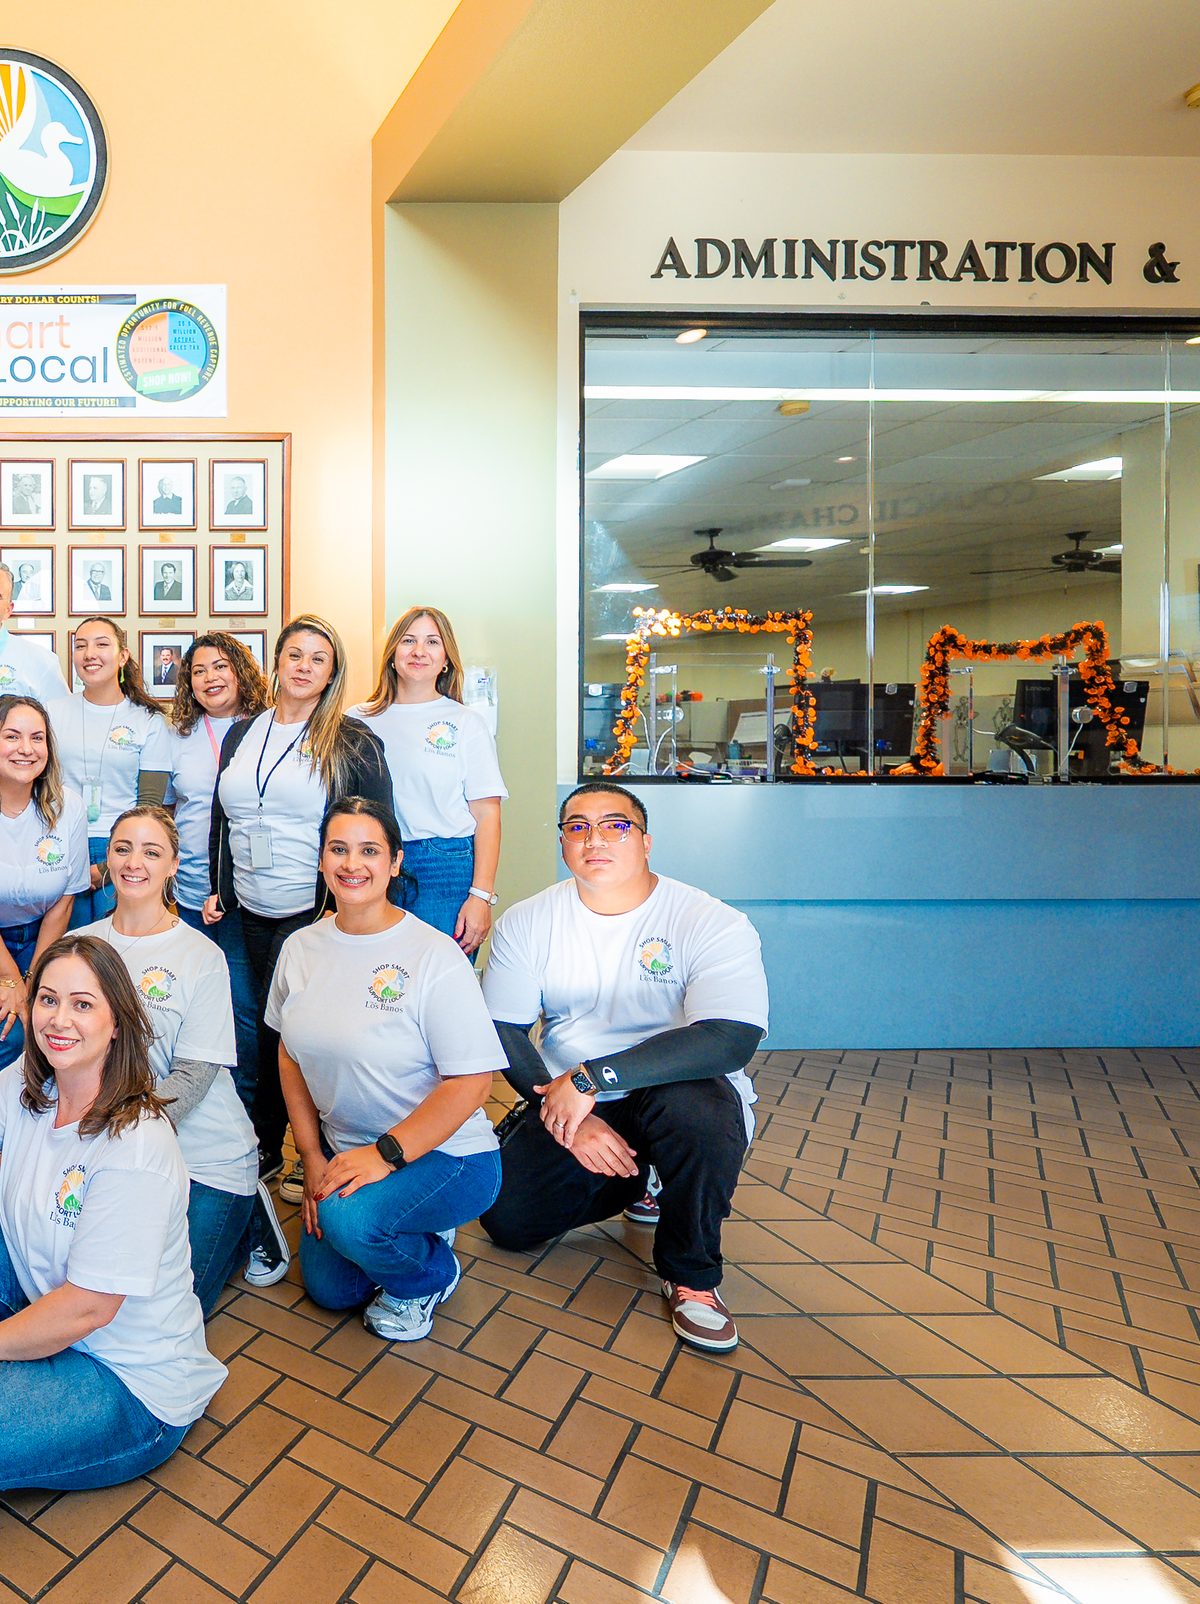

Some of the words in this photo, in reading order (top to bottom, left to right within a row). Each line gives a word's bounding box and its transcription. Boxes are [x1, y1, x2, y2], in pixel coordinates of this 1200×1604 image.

[651, 237, 1116, 285] ADMINISTRATION
[1143, 242, 1181, 284] &
[15, 295, 55, 304] DOLLAR
[57, 295, 100, 304] COUNTS!
[163, 301, 177, 309] FOR
[179, 303, 196, 316] FULL
[120, 301, 161, 338] OPPORTUNITY
[196, 314, 217, 346] REVENUE
[118, 340, 134, 381] ESTIMATED
[202, 349, 218, 381] CAPTURE
[143, 375, 165, 388] SHOP
[54, 398, 75, 407] OUR
[77, 398, 119, 407] FUTURE!
[45, 834, 63, 843] SMART
[639, 936, 655, 948] SHOP
[656, 936, 672, 951] SMART
[141, 966, 158, 975] SHOP
[159, 966, 177, 982] SMART
[372, 963, 390, 975] SHOP
[390, 964, 410, 979] SMART
[638, 960, 659, 976] SUPPORT
[659, 964, 674, 976] LOCAL
[653, 976, 678, 985] Banos
[135, 984, 155, 1001] SUPPORT
[155, 993, 172, 1002] LOCAL
[368, 986, 388, 1003] SUPPORT
[388, 992, 405, 1003] LOCAL
[146, 1001, 170, 1012] Banos
[365, 1001, 379, 1009] Los
[380, 1003, 404, 1013] Banos
